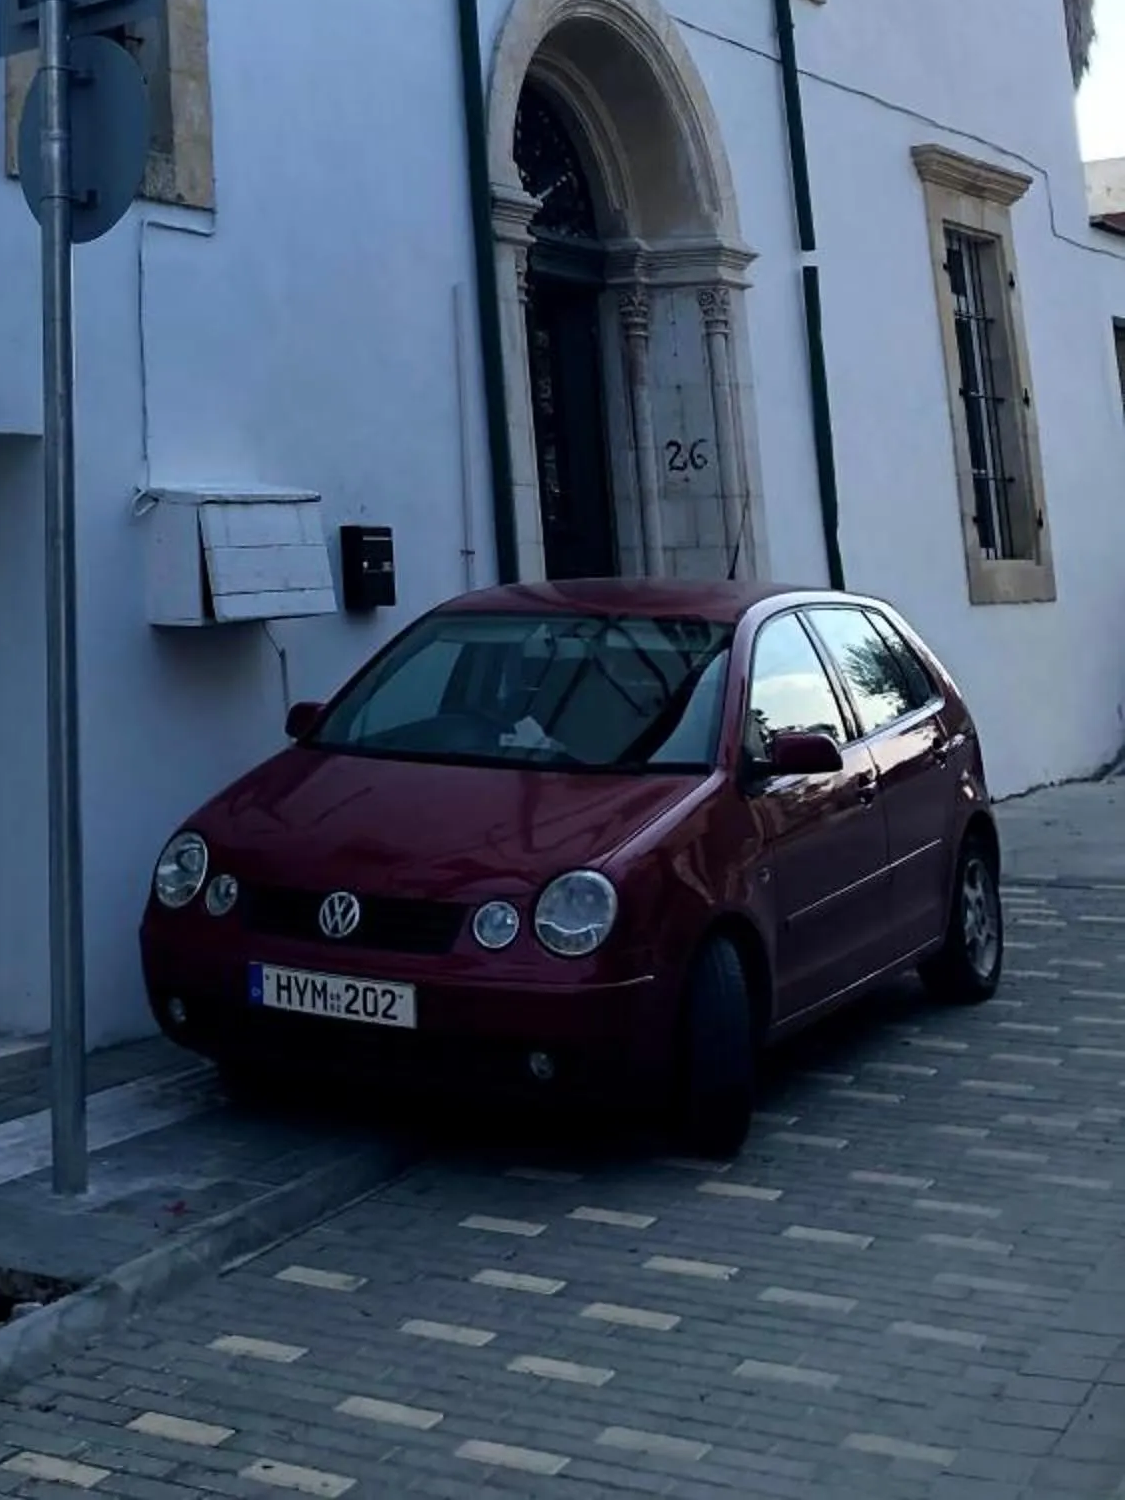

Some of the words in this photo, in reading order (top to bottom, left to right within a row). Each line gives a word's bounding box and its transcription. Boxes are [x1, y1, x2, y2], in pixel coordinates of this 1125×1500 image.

[665, 438, 709, 471] 26
[276, 973, 328, 1012] HYM
[344, 983, 398, 1020] 202
